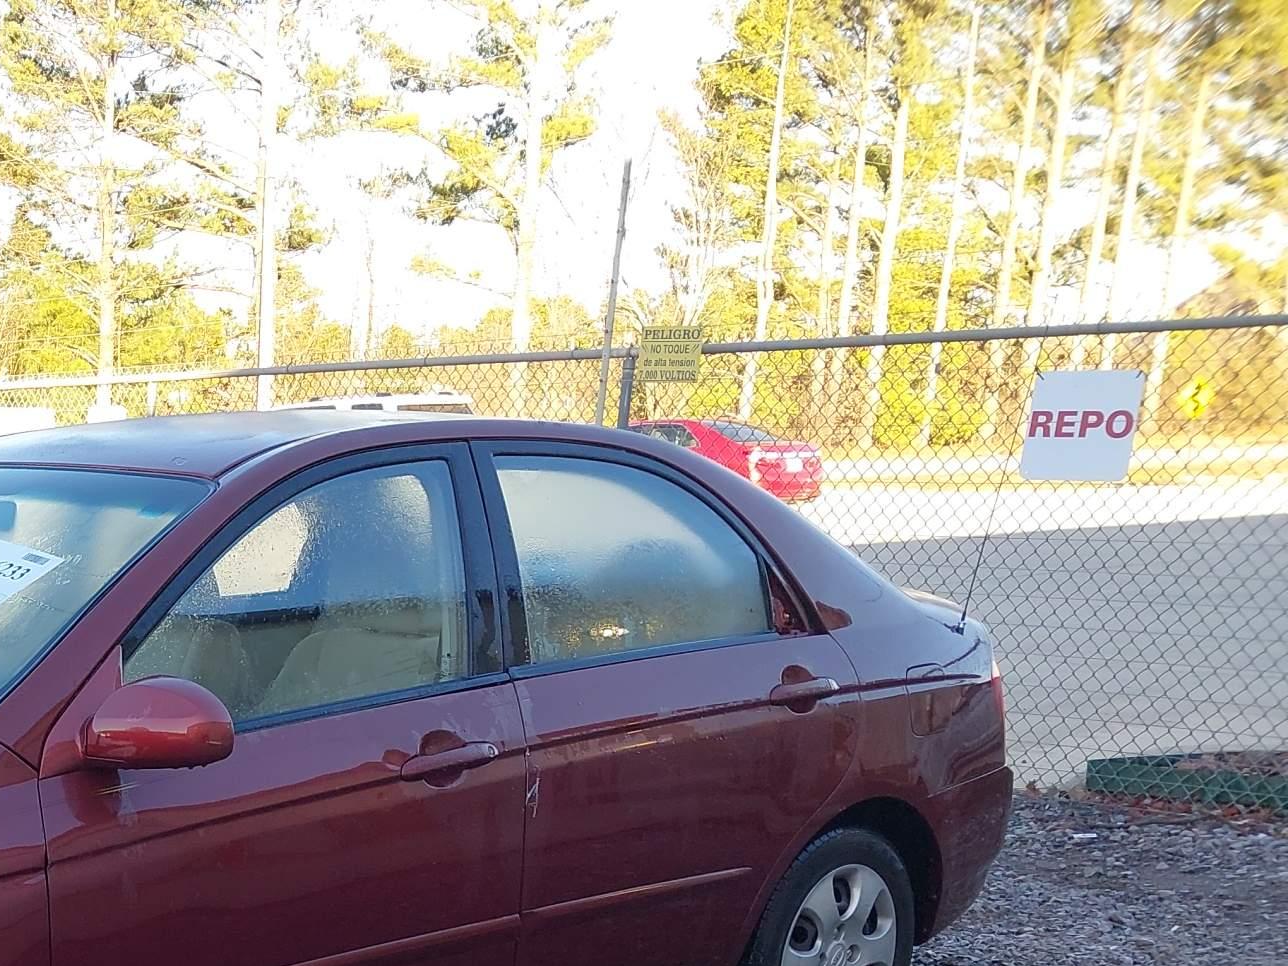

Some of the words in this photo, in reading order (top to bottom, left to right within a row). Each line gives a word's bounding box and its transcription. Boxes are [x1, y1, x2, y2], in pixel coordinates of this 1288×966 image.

[644, 329, 701, 340] PELIGRO
[650, 344, 662, 354] NO
[663, 344, 690, 354] TOQUE
[643, 357, 653, 367] de
[654, 357, 667, 367] alta
[660, 370, 697, 380] VOLTIOS
[1028, 410, 1134, 438] REPO
